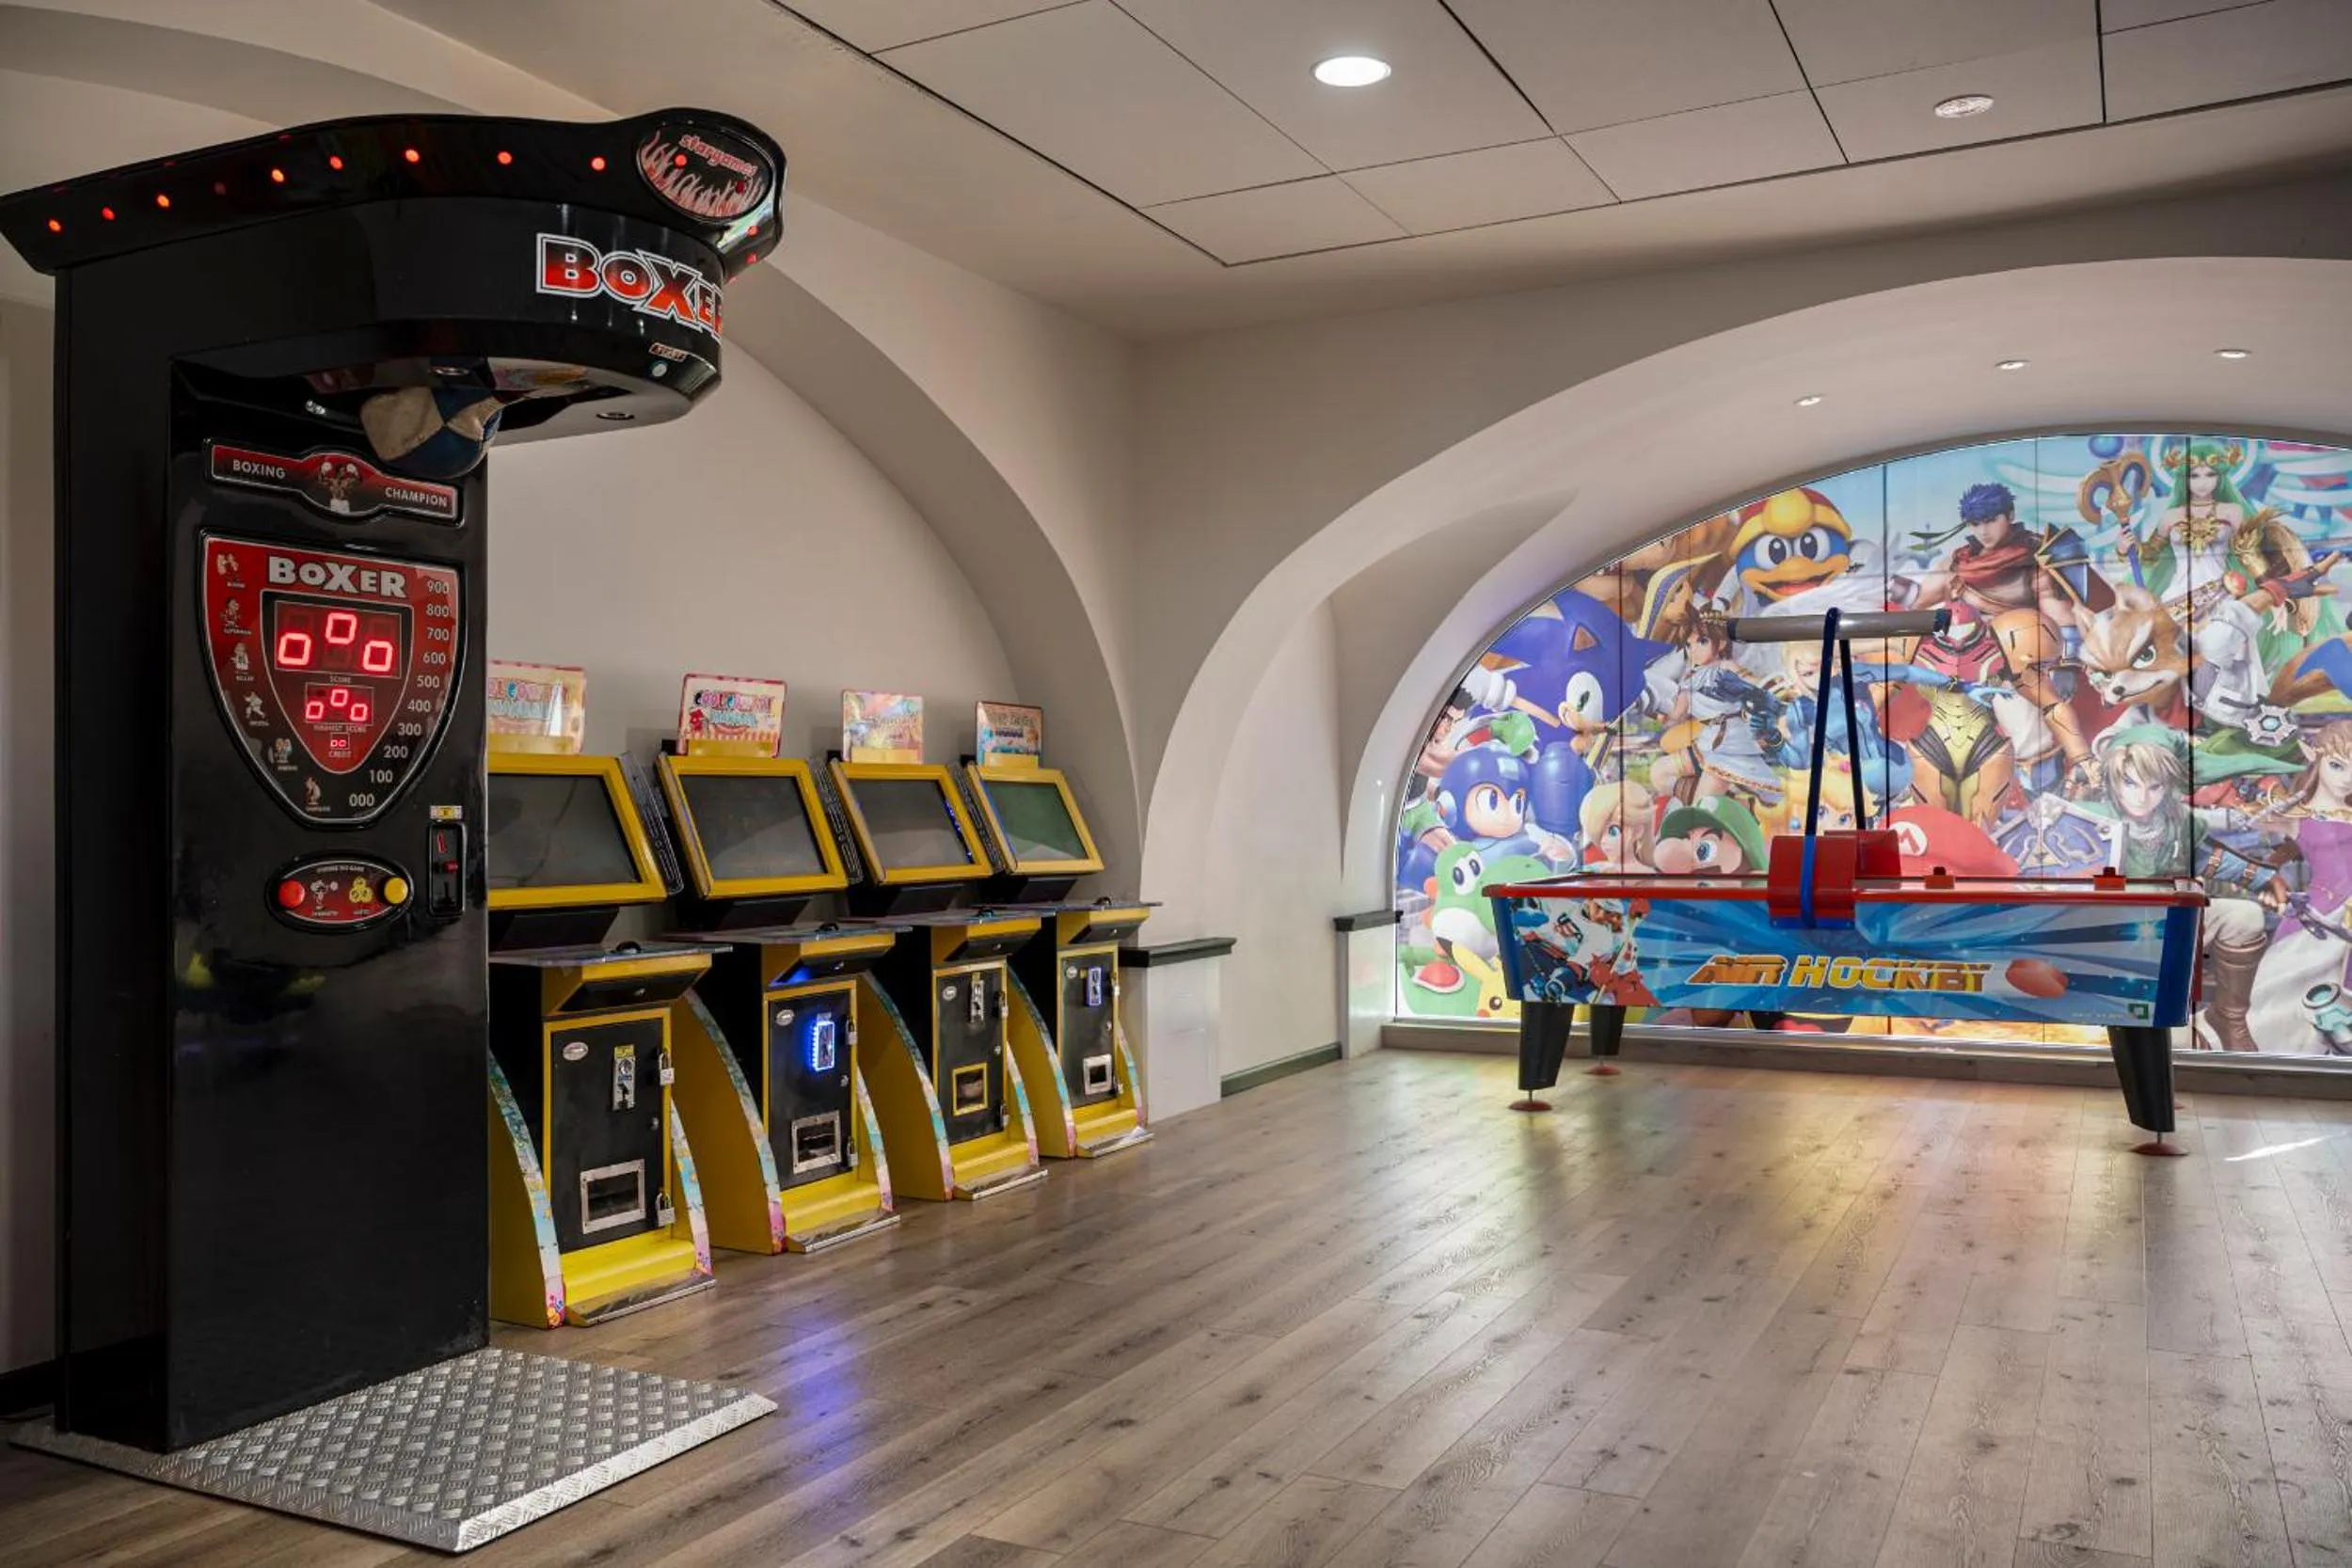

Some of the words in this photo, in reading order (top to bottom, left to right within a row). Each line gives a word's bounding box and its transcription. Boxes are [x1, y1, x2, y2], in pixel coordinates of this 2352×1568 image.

[536, 233, 723, 344] BOXE
[232, 459, 286, 480] BOXING
[385, 487, 448, 508] CHAMPION
[268, 556, 406, 598] BOXER
[426, 579, 450, 594] 900
[425, 604, 450, 618] 800
[426, 627, 450, 641] 700
[423, 652, 447, 665] 600
[417, 674, 440, 689] 500
[407, 699, 431, 713] 400
[397, 722, 422, 736] 300
[383, 745, 408, 759] 200
[369, 769, 393, 784] 100
[348, 793, 375, 807] 000
[1685, 954, 1787, 987] AIR
[1788, 955, 1994, 993] HOCKEY
